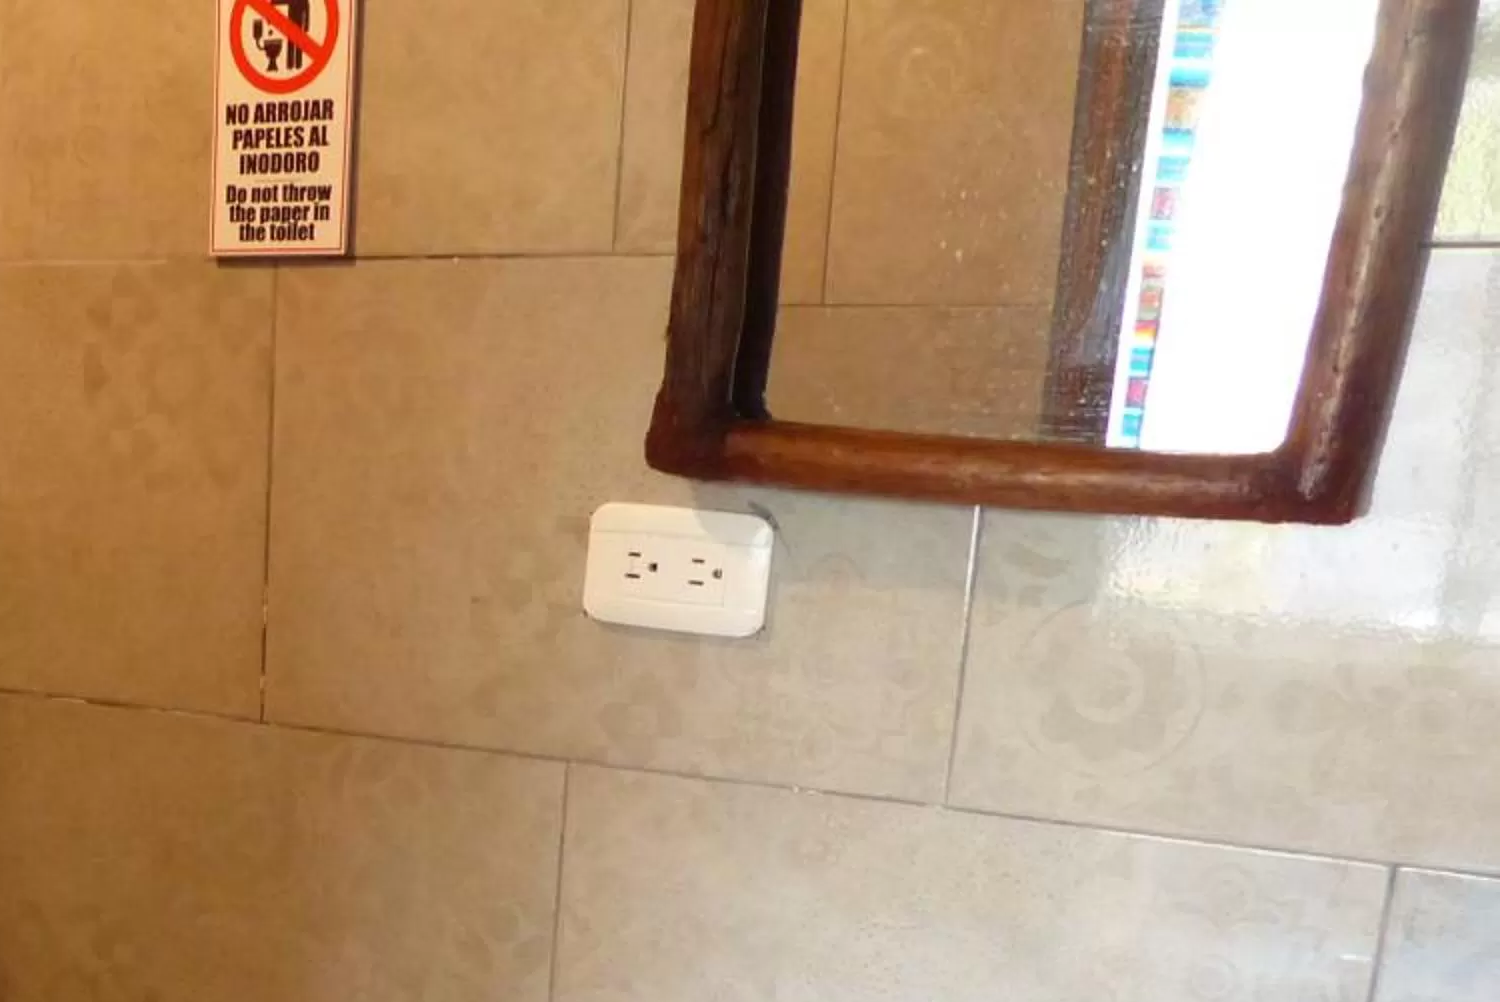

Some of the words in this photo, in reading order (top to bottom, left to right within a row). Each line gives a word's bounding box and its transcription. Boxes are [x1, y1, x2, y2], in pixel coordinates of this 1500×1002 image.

[225, 104, 249, 125] NO
[253, 99, 334, 123] ARROJAR
[232, 127, 304, 150] PAPELES
[308, 125, 329, 147] AL
[239, 151, 320, 175] INODORO
[226, 185, 248, 204] Do
[251, 185, 278, 203] not
[282, 183, 332, 201] throw
[230, 204, 256, 222] the
[260, 205, 309, 224] paper
[313, 202, 330, 220] in
[239, 223, 266, 242] the
[269, 222, 315, 241] toilet
